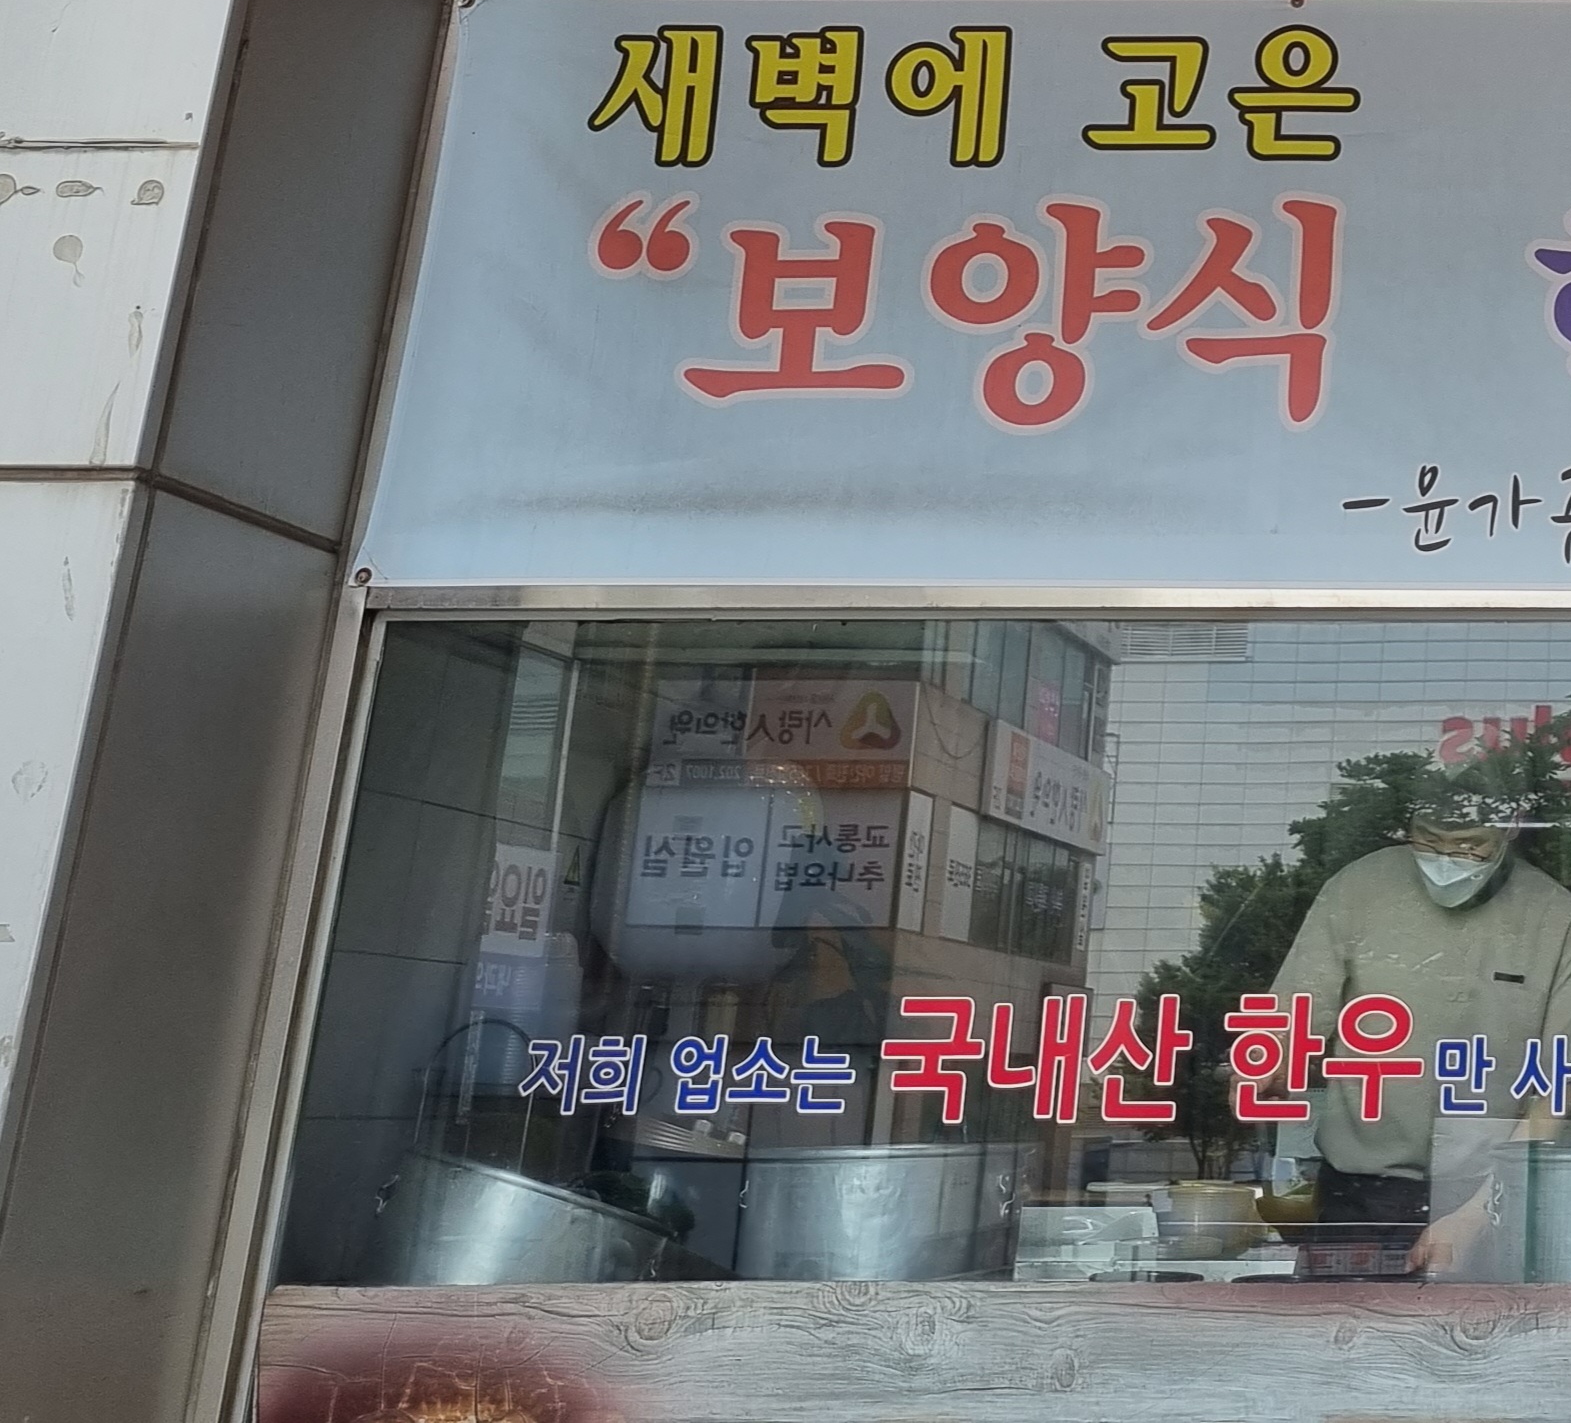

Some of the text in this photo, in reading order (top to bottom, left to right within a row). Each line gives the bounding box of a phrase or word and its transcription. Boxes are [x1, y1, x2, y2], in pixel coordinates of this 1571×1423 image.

[588, 24, 1361, 167] 새벽에 고은
[517, 1033, 648, 1116] 저희
[669, 1034, 857, 1116] 업소는
[880, 993, 1194, 1124] 국내산
